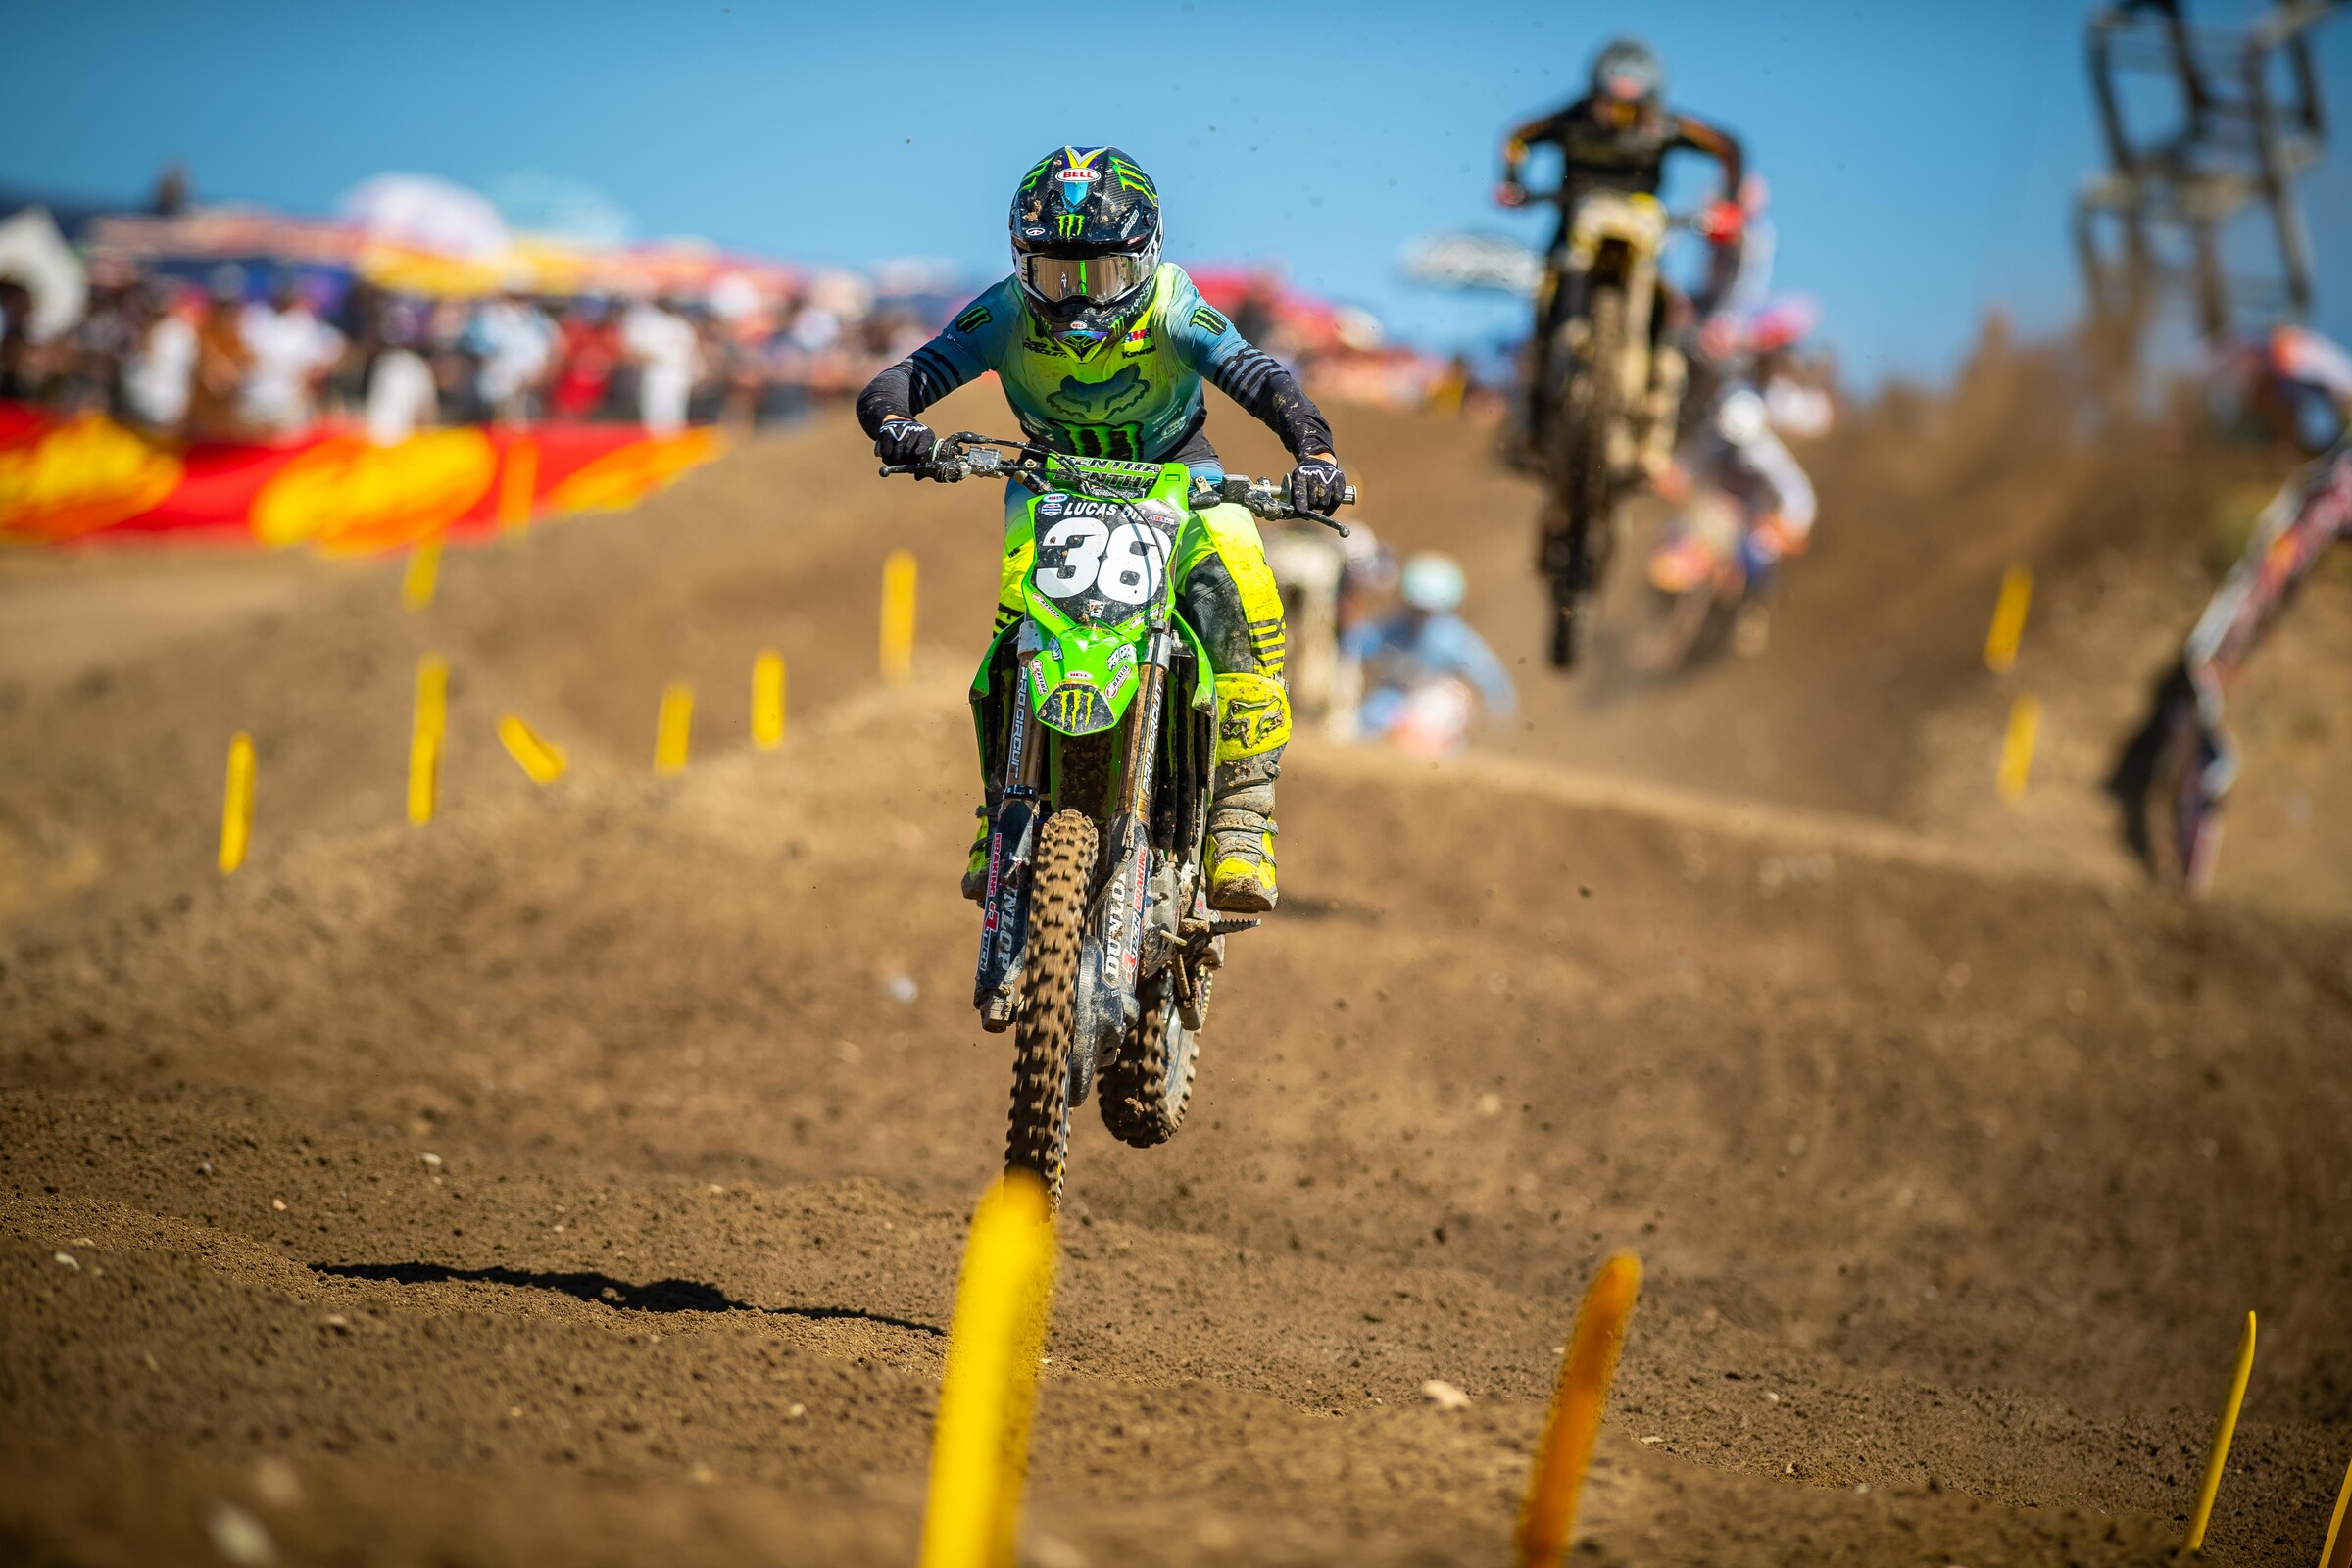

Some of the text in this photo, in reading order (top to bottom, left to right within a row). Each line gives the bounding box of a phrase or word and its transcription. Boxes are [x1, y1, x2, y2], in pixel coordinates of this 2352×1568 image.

[1063, 502, 1119, 516] LUCAS
[1035, 516, 1172, 605] 38
[1016, 666, 1029, 706] PRO
[1142, 677, 1163, 796] PRO CIRCUIT
[988, 833, 1002, 898] BRAKING
[1133, 845, 1148, 913] BRAKING
